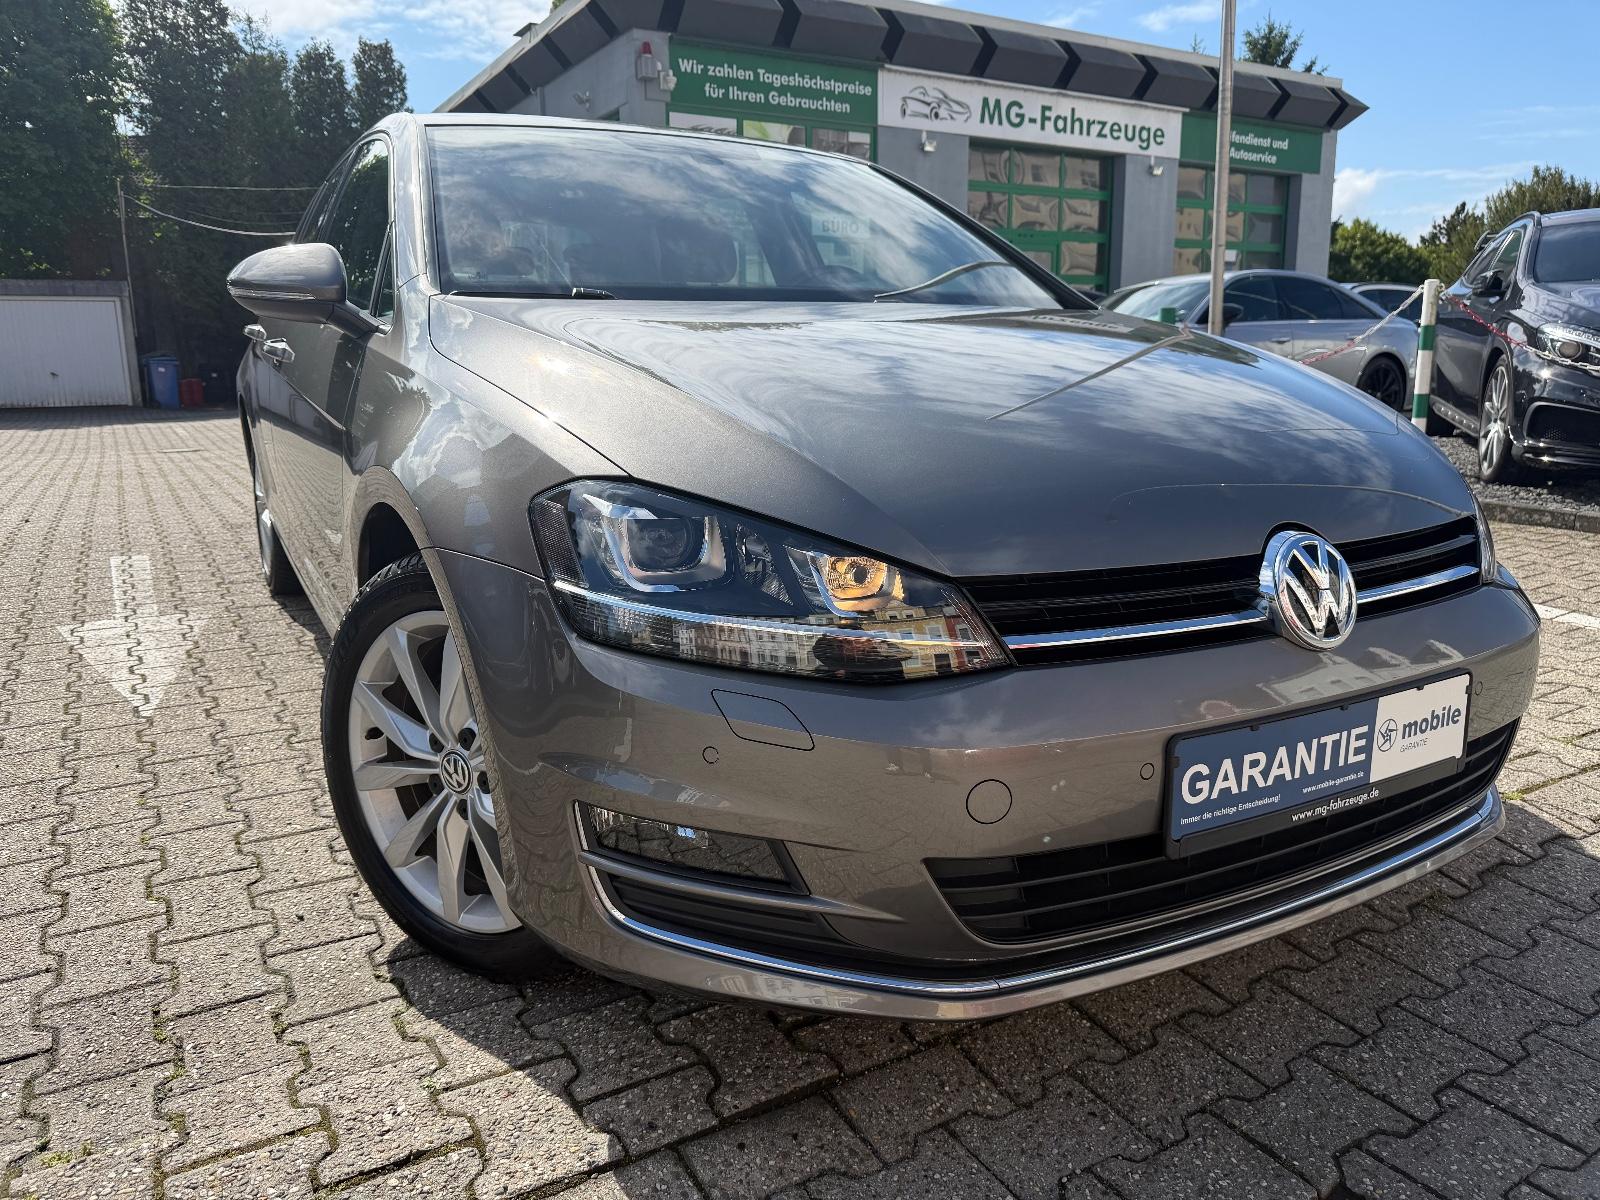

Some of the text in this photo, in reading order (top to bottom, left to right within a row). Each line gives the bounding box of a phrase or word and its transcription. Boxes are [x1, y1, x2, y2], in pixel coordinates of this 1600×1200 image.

[678, 58, 873, 96] Wir zahlen Tageshöchstpreise
[704, 83, 851, 113] für Ihren Gebrauchten
[979, 96, 1165, 151] MG-Fahrzeuge
[1229, 130, 1289, 150] fendienst und
[1229, 146, 1277, 165] Autoservice
[822, 216, 860, 234] BÜRO
[1401, 704, 1462, 740] mobile
[1400, 737, 1429, 753] GARANTIE
[1180, 724, 1370, 805] GARANTIE
[1302, 770, 1365, 794] www.mobile-garantie.de
[1180, 793, 1281, 825] Immer die richtige Entscheidung!
[1291, 786, 1380, 822] www.mg-fahrzeuge.de
